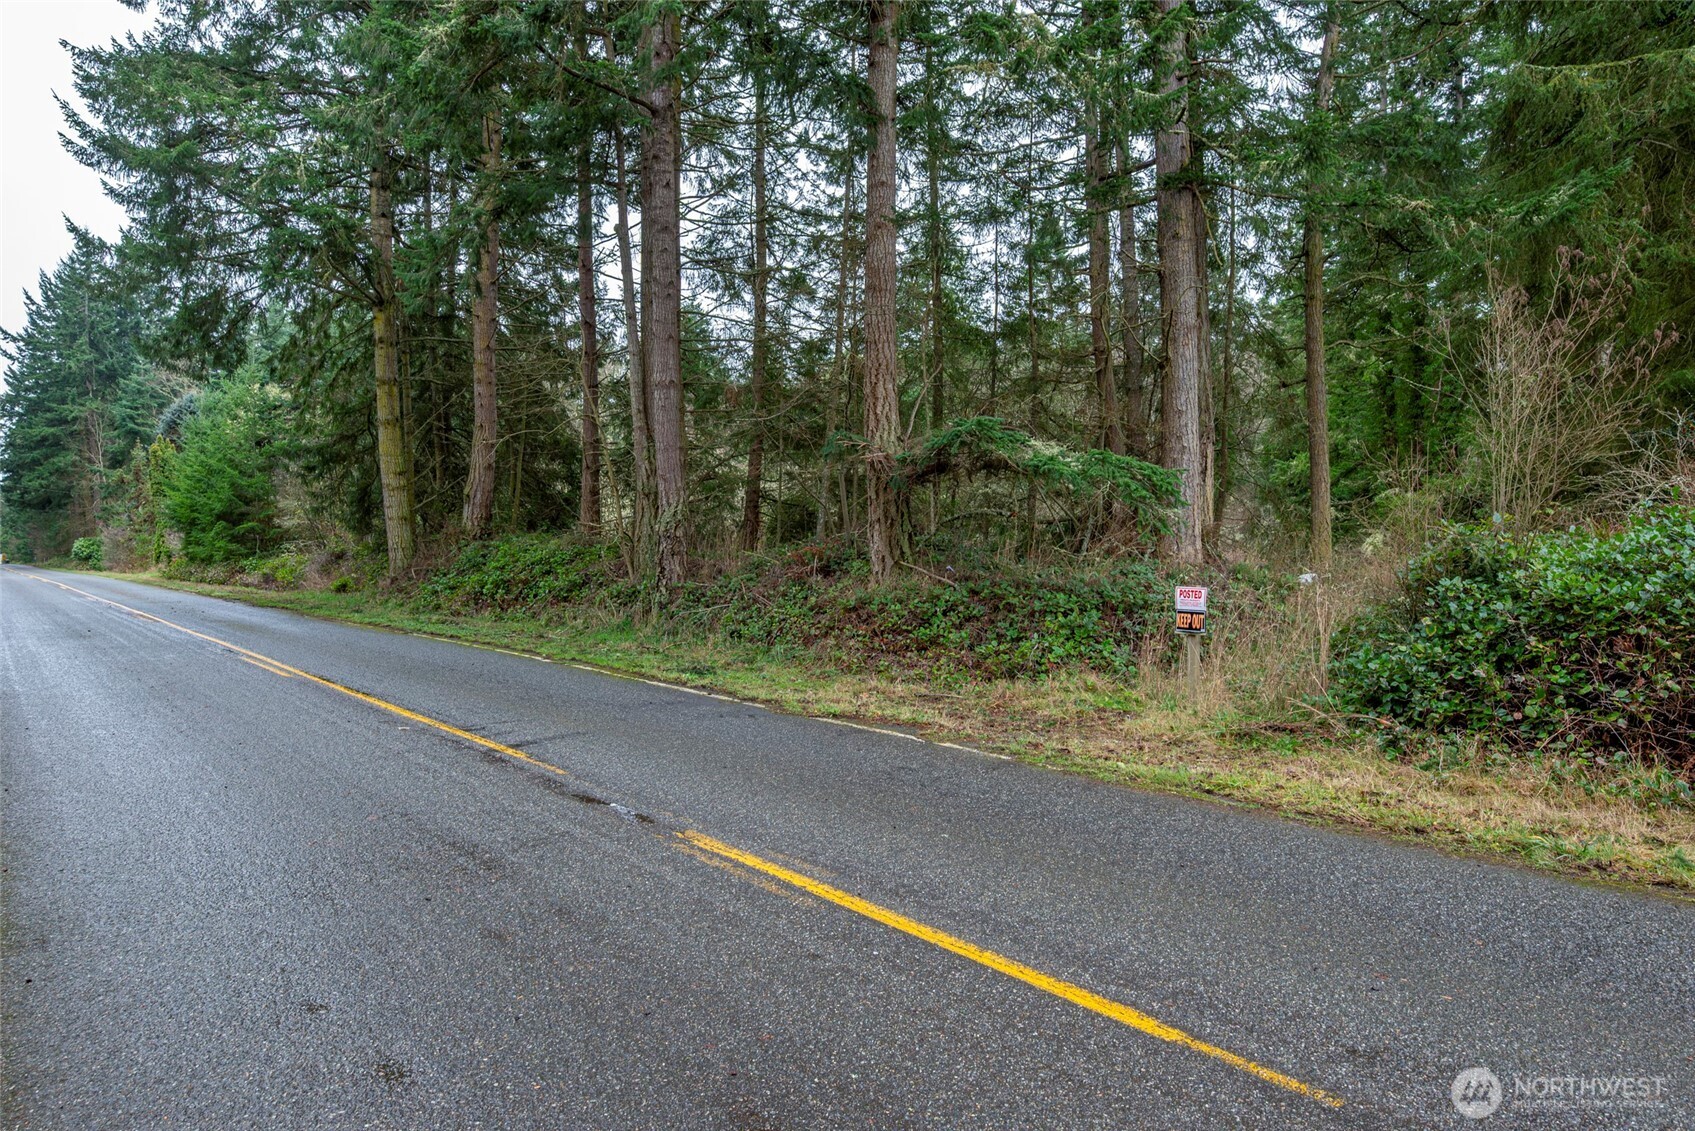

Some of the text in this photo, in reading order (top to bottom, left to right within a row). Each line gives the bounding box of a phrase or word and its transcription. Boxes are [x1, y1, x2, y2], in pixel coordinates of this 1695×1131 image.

[1179, 590, 1202, 599] POSTED
[1177, 613, 1204, 629] KEEP OUT
